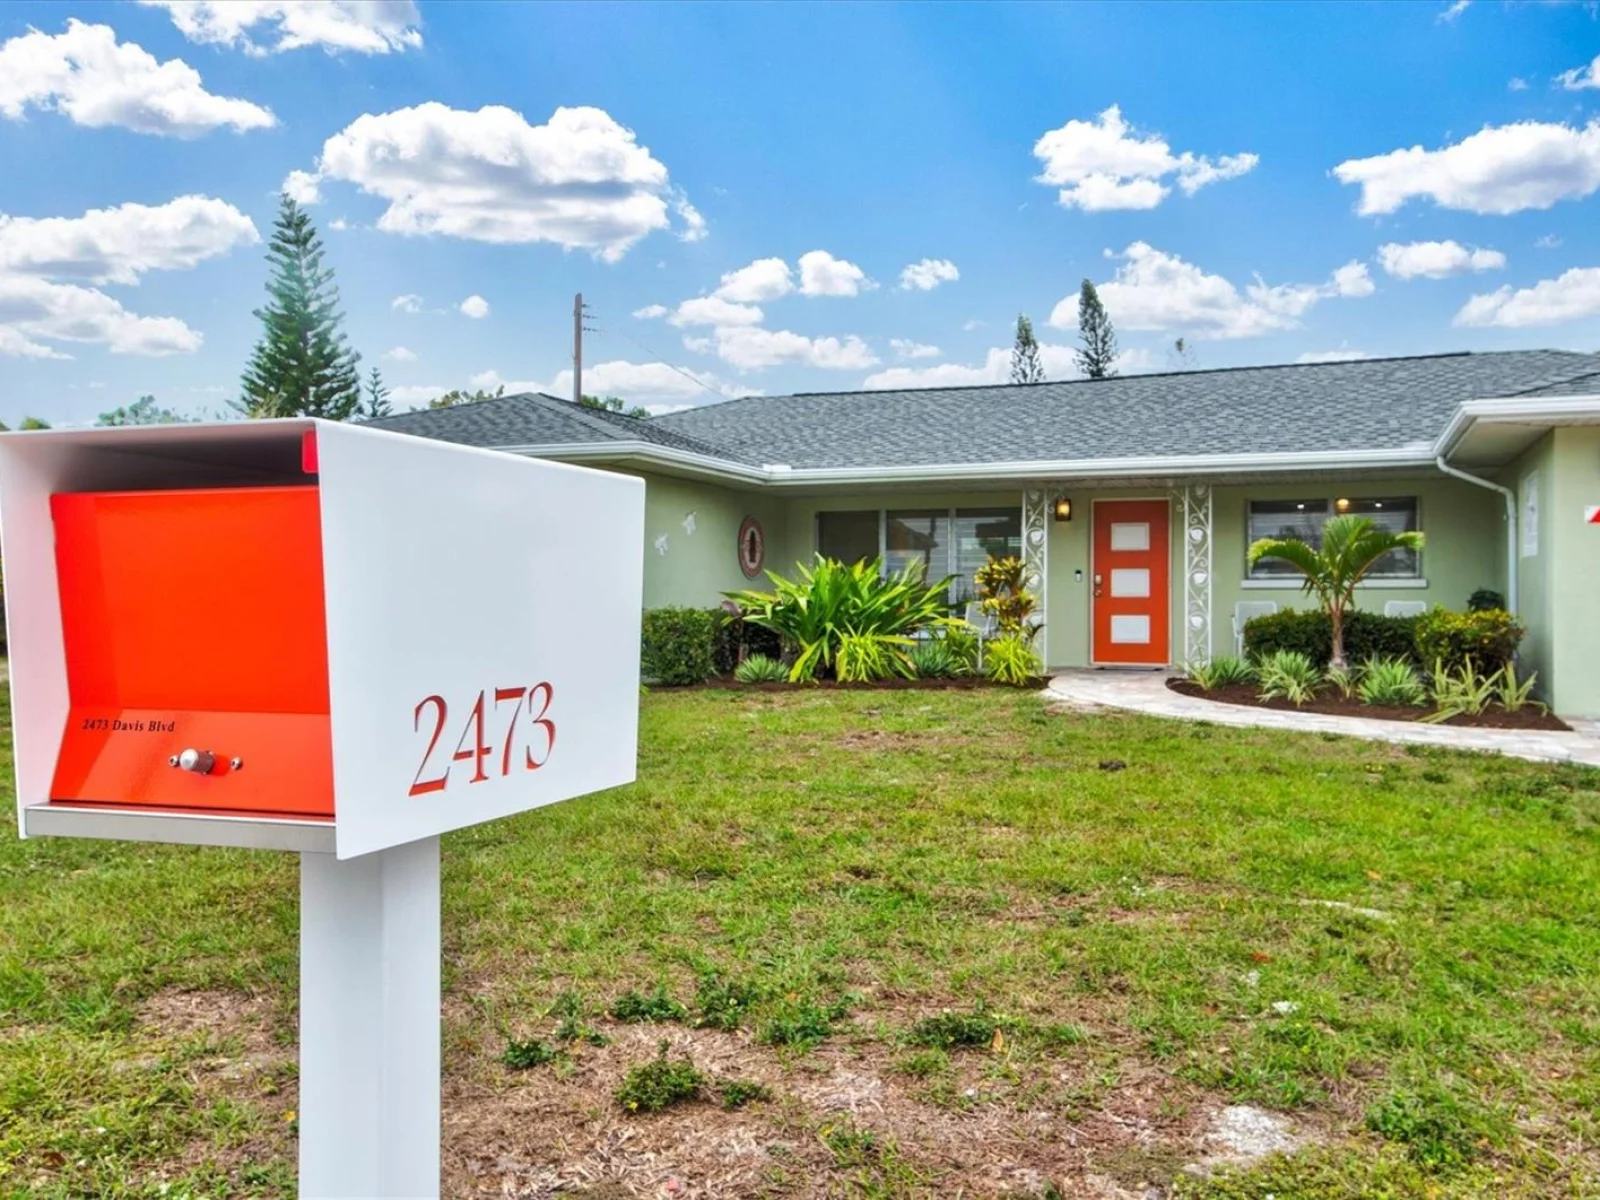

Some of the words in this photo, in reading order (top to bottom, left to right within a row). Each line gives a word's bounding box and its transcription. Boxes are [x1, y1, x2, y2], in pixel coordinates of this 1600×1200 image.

[82, 719, 109, 730] 2473
[112, 719, 144, 731] Davis
[148, 720, 175, 732] Blvd
[408, 681, 556, 796] 2473
